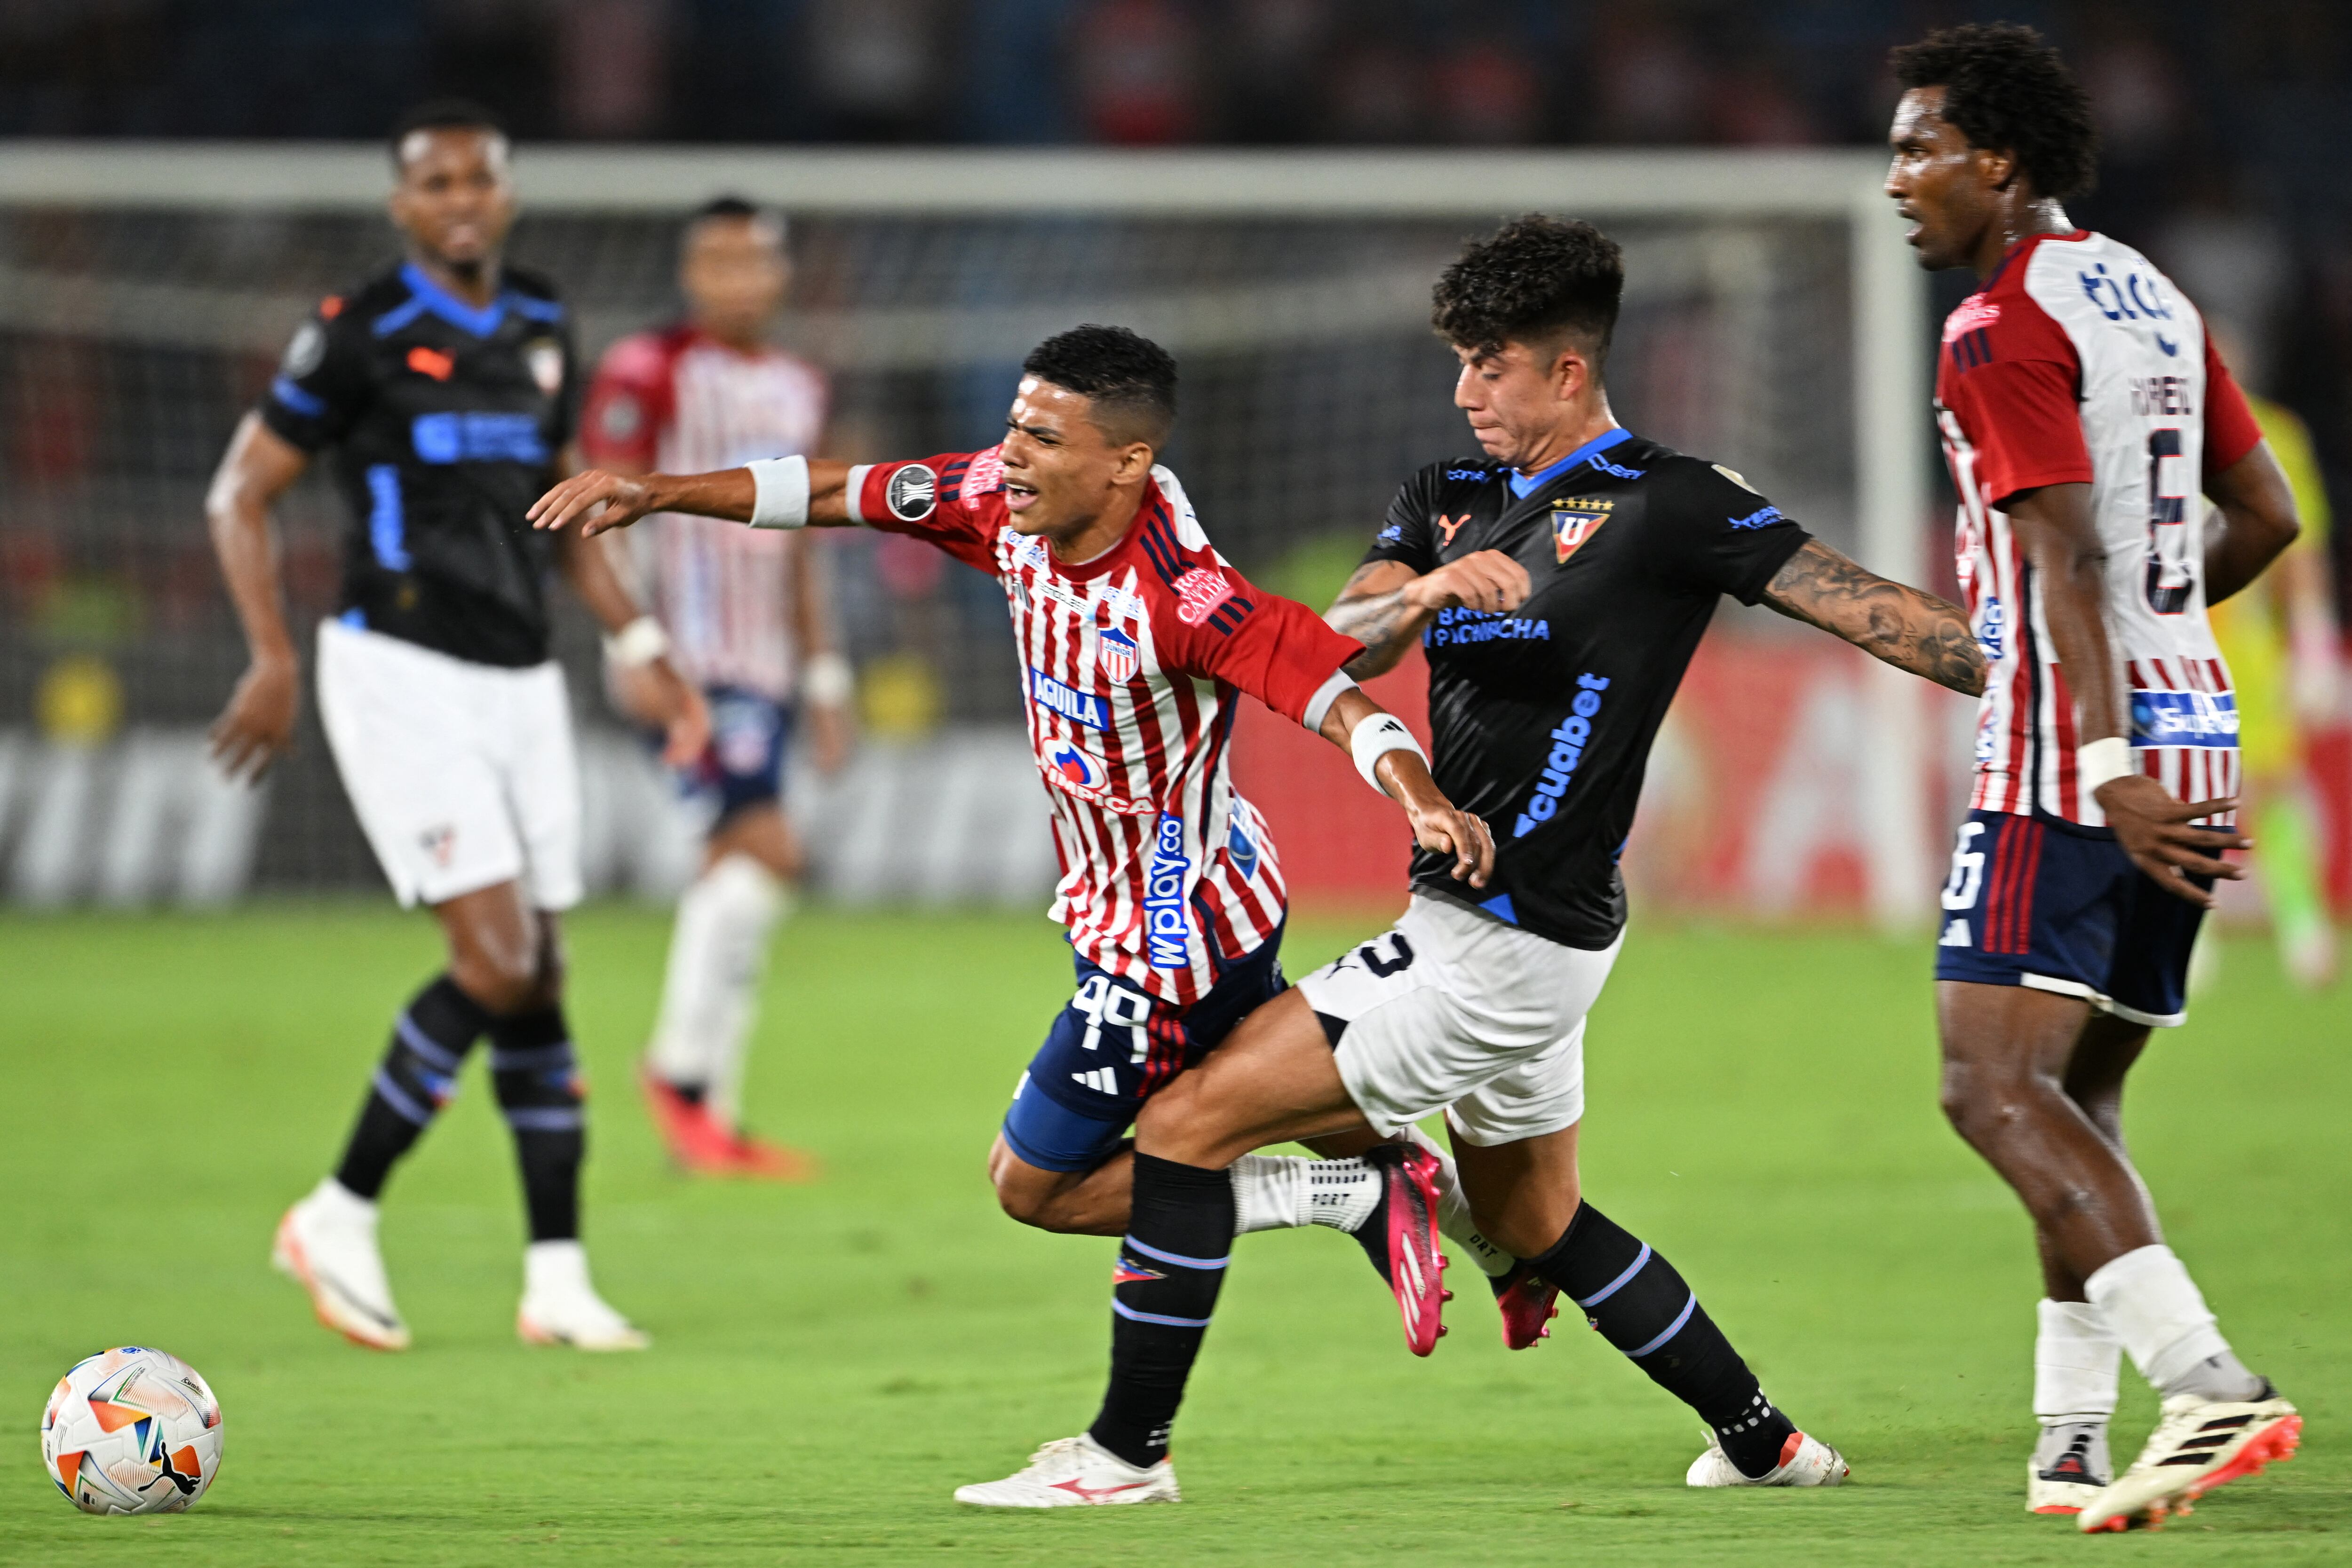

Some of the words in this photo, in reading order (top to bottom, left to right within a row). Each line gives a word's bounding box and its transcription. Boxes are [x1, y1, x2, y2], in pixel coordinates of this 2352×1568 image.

[1560, 517, 1589, 546] U
[1172, 568, 1208, 594] RON
[1177, 576, 1231, 623] CALDA
[1438, 606, 1506, 626] BAN
[1033, 671, 1103, 728] AGUILA
[1041, 759, 1157, 813] IMPICA
